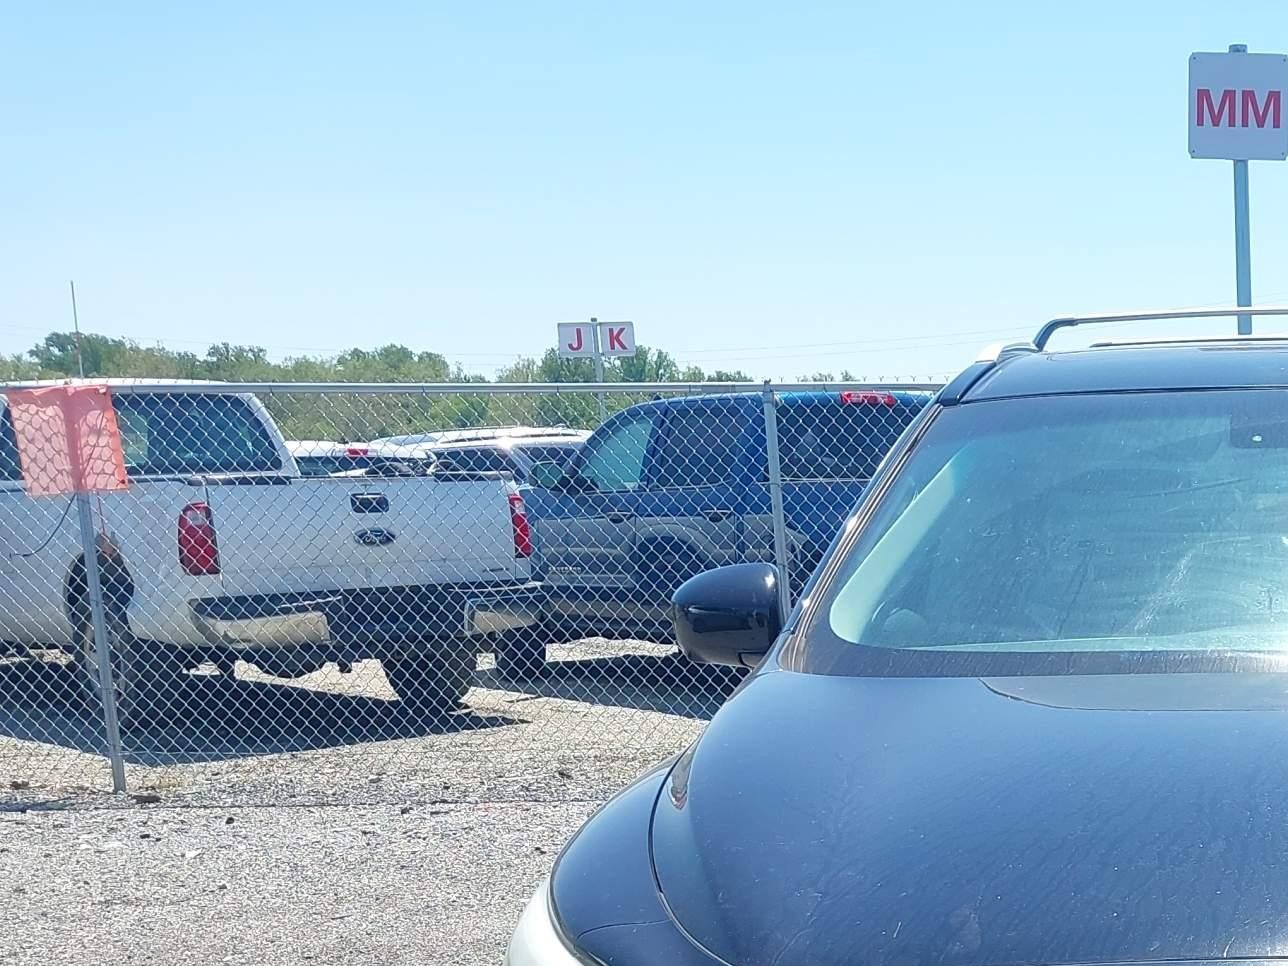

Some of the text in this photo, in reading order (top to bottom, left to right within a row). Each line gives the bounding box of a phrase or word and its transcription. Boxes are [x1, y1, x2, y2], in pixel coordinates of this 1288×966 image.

[1196, 88, 1282, 129] MM
[567, 327, 583, 352] J
[608, 327, 629, 351] K
